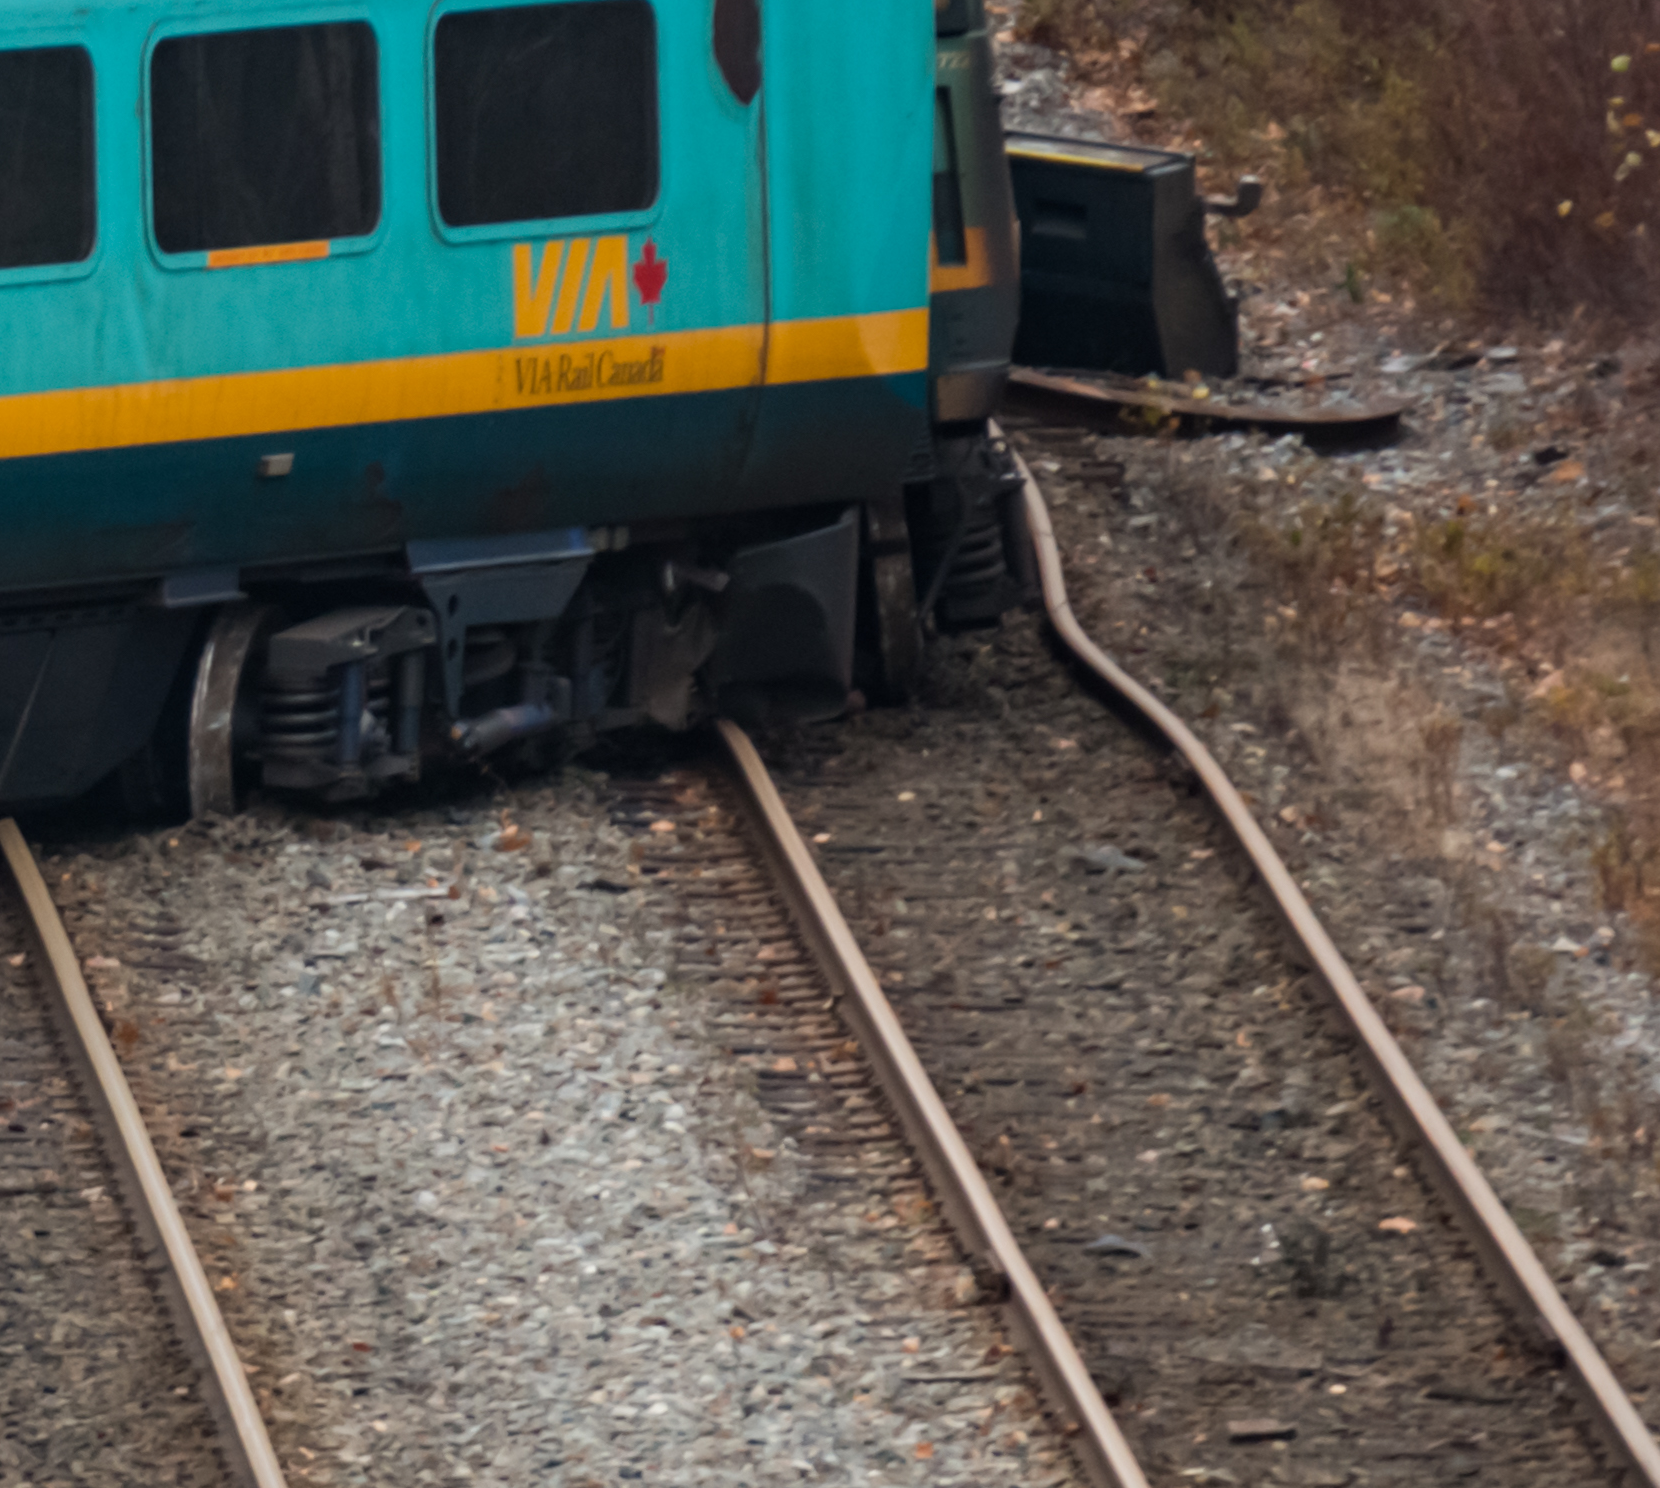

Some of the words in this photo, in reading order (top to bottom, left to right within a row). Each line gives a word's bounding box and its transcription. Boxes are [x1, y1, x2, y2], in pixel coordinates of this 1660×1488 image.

[513, 234, 630, 340] VIA
[515, 357, 552, 395] VIA
[557, 352, 595, 392] Rail
[596, 349, 665, 388] Canada
